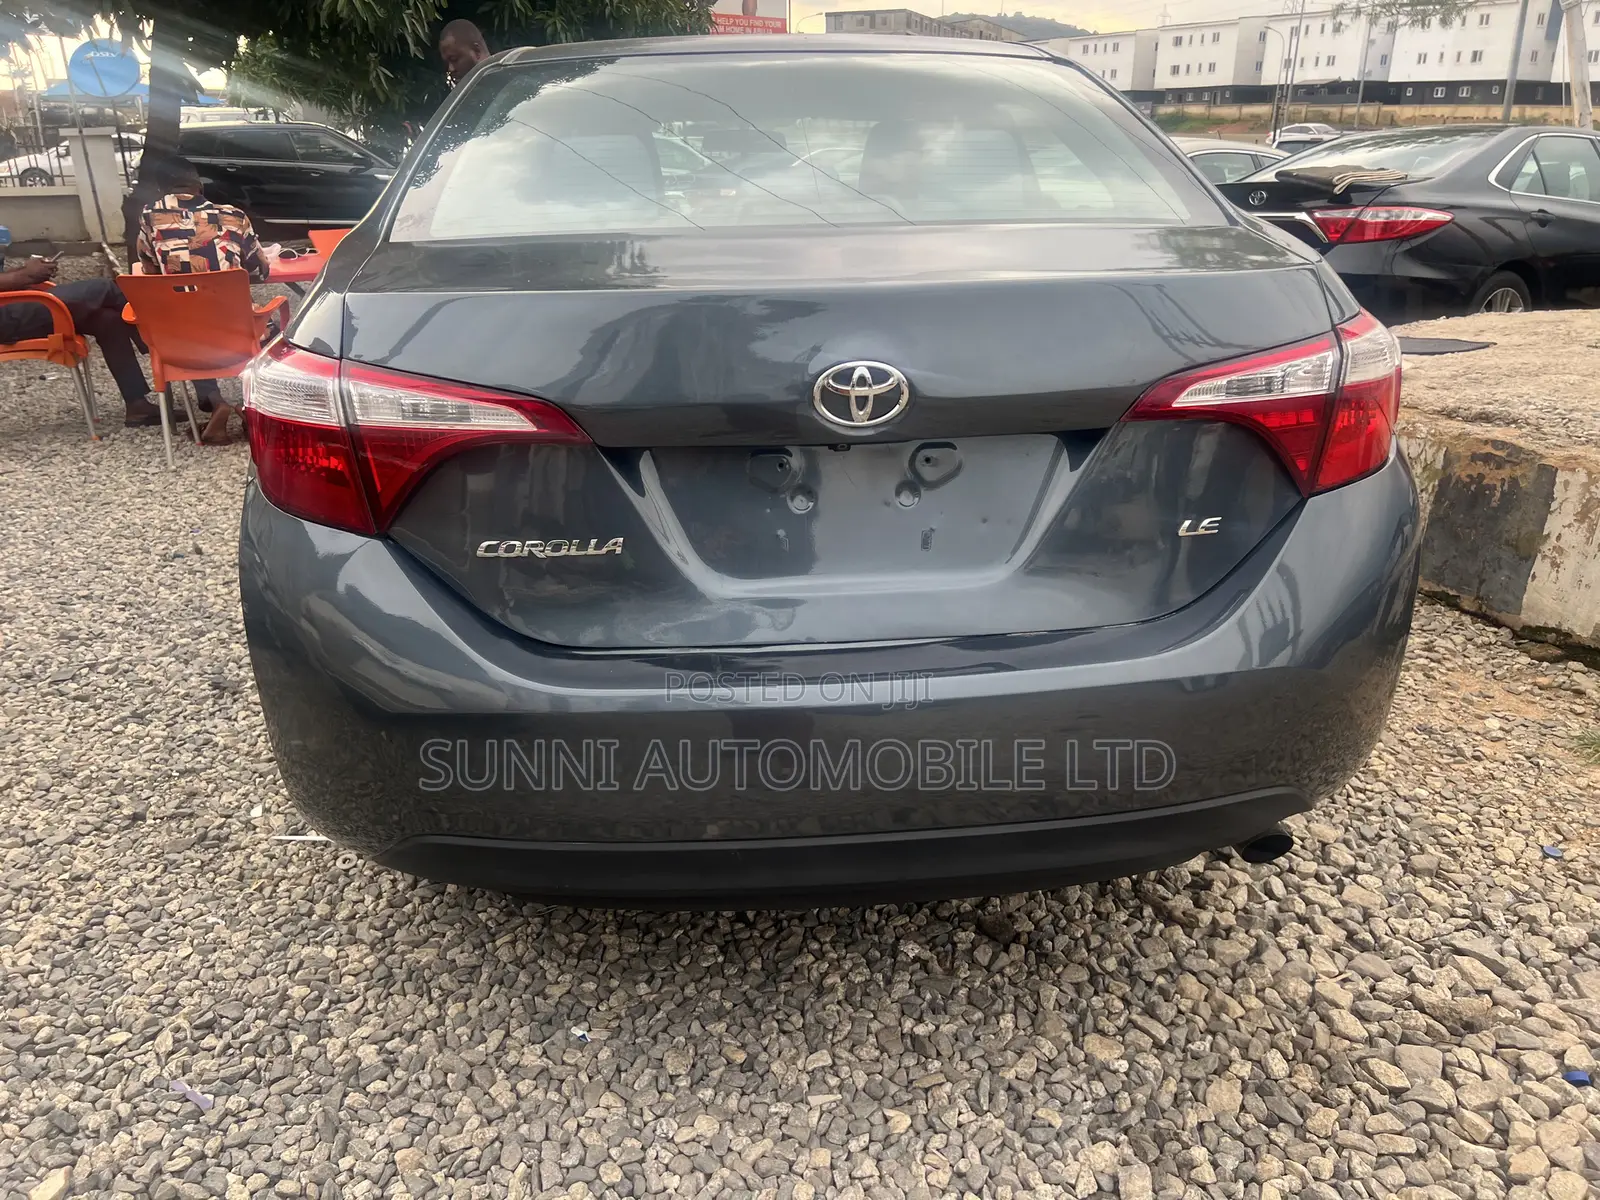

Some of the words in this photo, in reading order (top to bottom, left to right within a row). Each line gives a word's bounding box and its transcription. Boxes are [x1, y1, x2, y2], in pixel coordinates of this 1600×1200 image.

[717, 17, 734, 25] HELP
[734, 18, 749, 26] YOU
[749, 19, 763, 27] FIND
[764, 20, 782, 28] YOUR
[726, 26, 744, 34] HOME
[1178, 517, 1222, 536] LE
[476, 537, 624, 559] COROLLA
